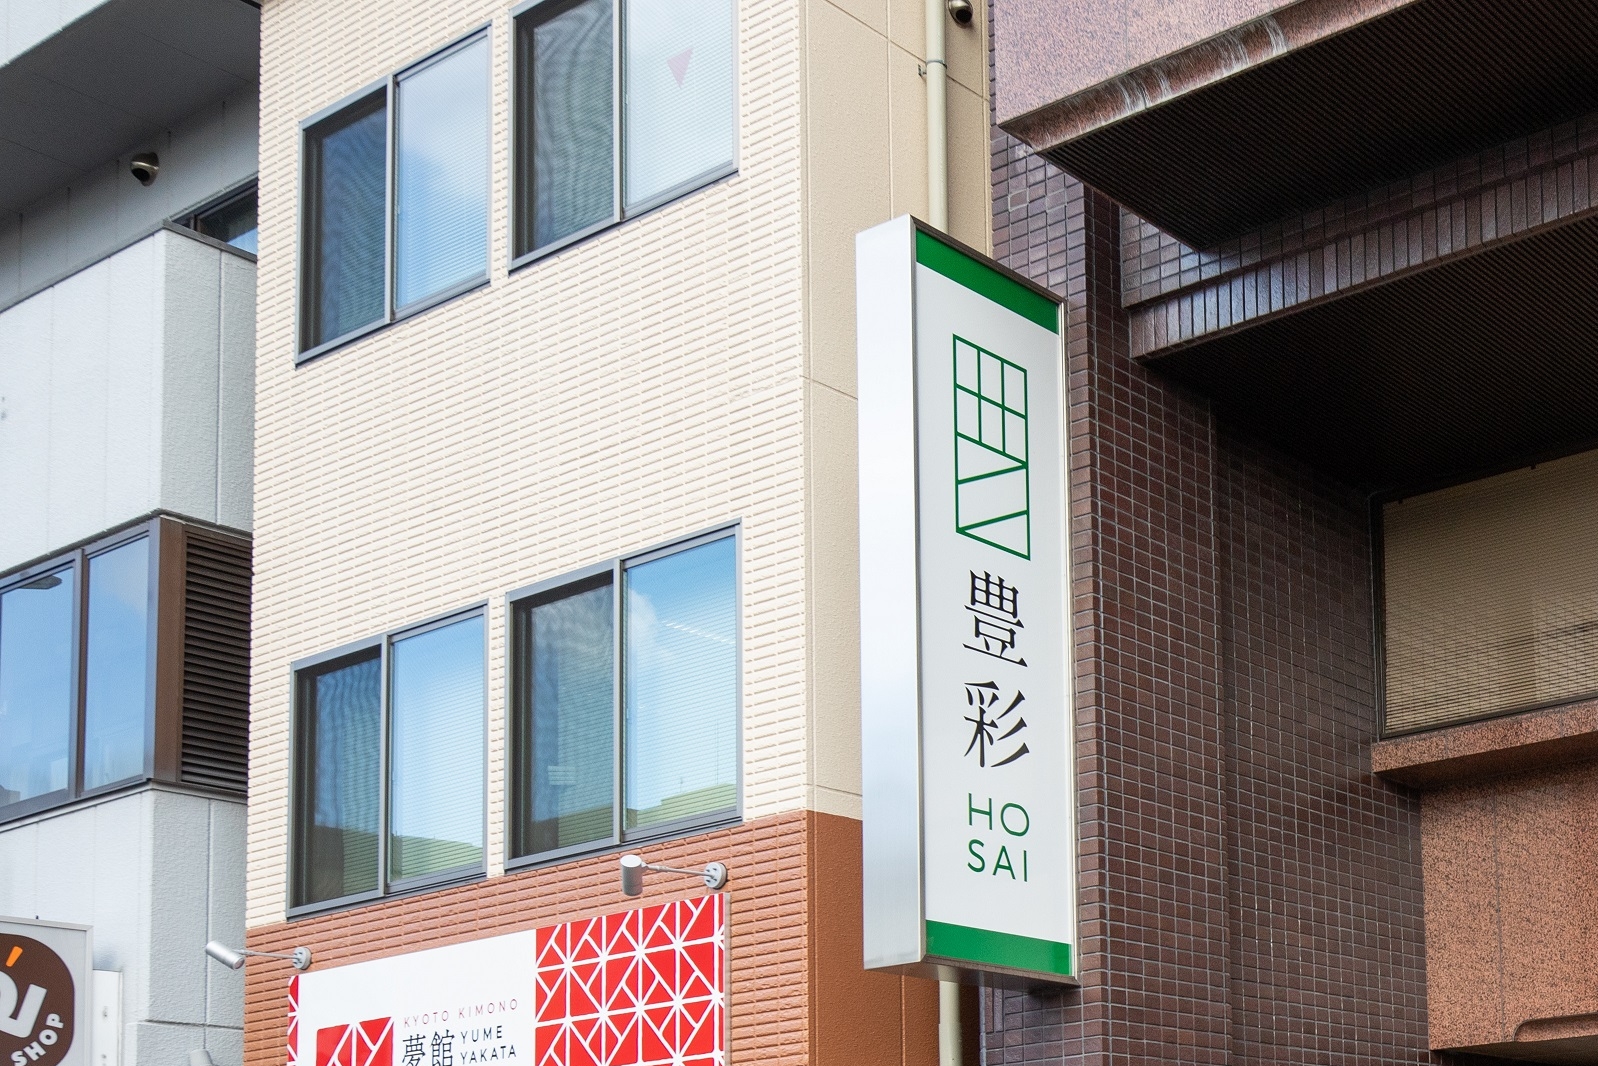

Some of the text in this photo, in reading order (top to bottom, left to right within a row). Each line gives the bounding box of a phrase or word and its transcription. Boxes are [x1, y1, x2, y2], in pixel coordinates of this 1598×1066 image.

[962, 569, 1030, 769] 豊彩
[967, 792, 1030, 839] HO
[967, 839, 1029, 884] SAI
[403, 998, 519, 1029] KYOTO KIMONO
[460, 1025, 504, 1046] YUME
[460, 1044, 517, 1066] YAKATA
